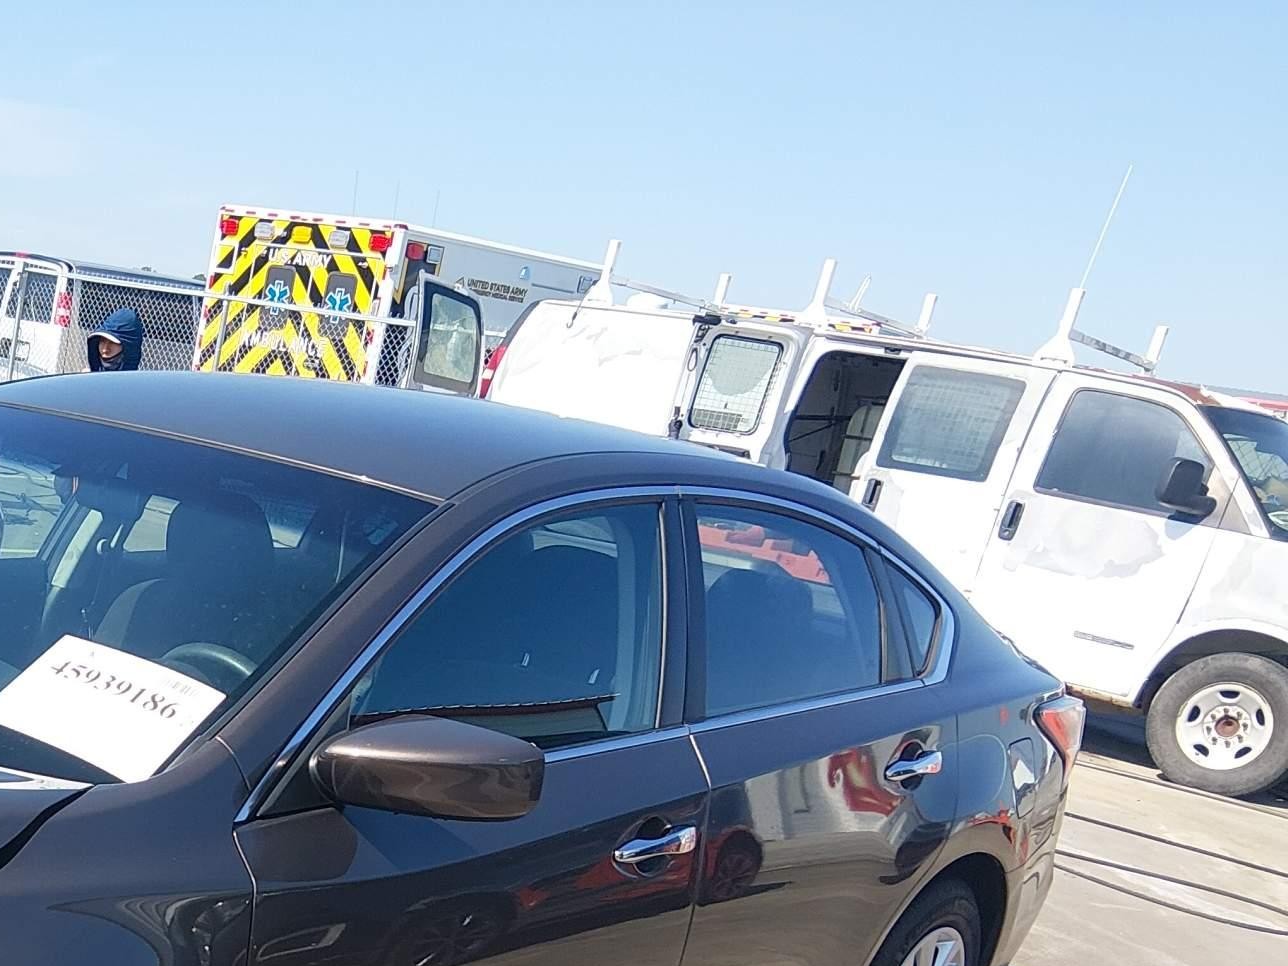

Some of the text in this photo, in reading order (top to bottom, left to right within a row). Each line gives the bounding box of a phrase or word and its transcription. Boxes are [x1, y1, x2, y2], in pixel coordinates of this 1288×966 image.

[293, 251, 332, 269] ARMY
[467, 278, 489, 290] UNITED
[490, 282, 510, 294] STATES
[511, 287, 528, 297] ARMY
[244, 330, 326, 357] AMBULANCE
[50, 660, 178, 720] 45939186
